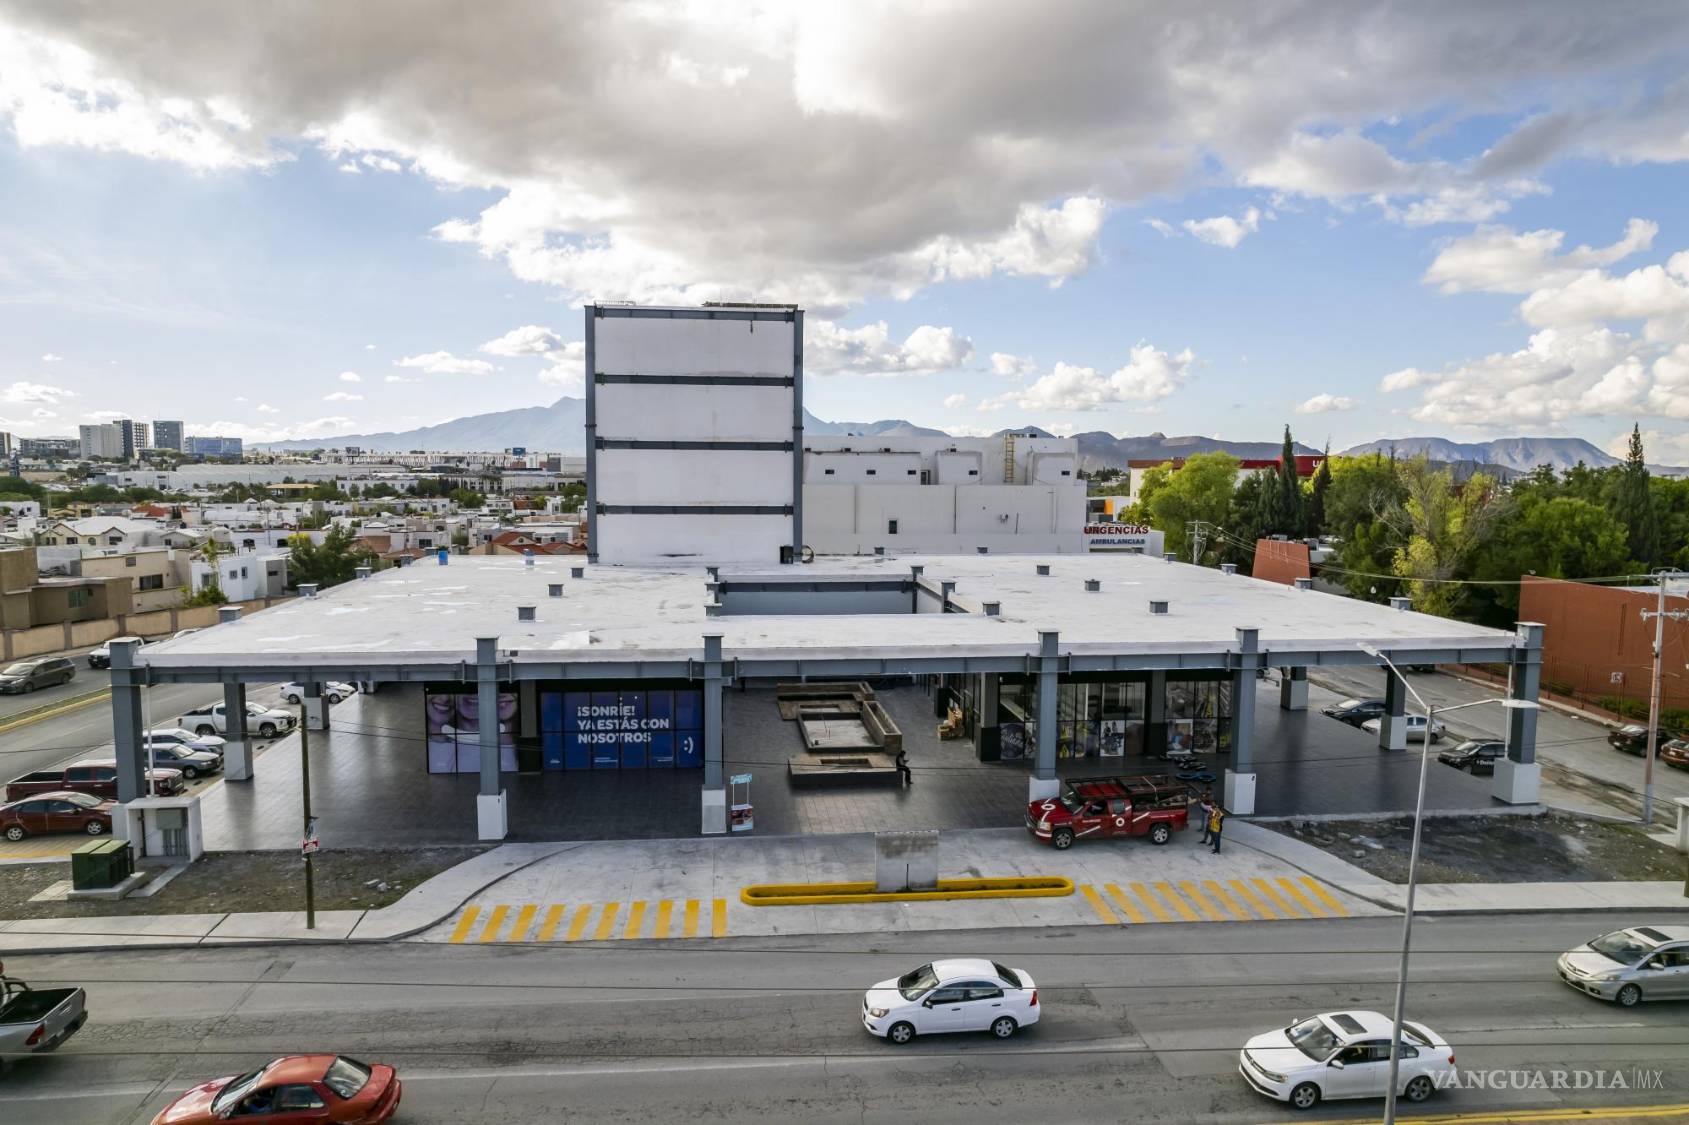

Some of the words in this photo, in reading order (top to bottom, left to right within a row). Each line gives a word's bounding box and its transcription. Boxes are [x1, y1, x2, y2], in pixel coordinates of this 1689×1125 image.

[1084, 526, 1149, 534] URGENCIAS
[577, 703, 635, 717] ¡SONRÍE!
[577, 719, 596, 731] YA
[597, 716, 639, 730] ESTÁS
[640, 718, 669, 729] CON
[578, 731, 652, 743] NOSOTROS
